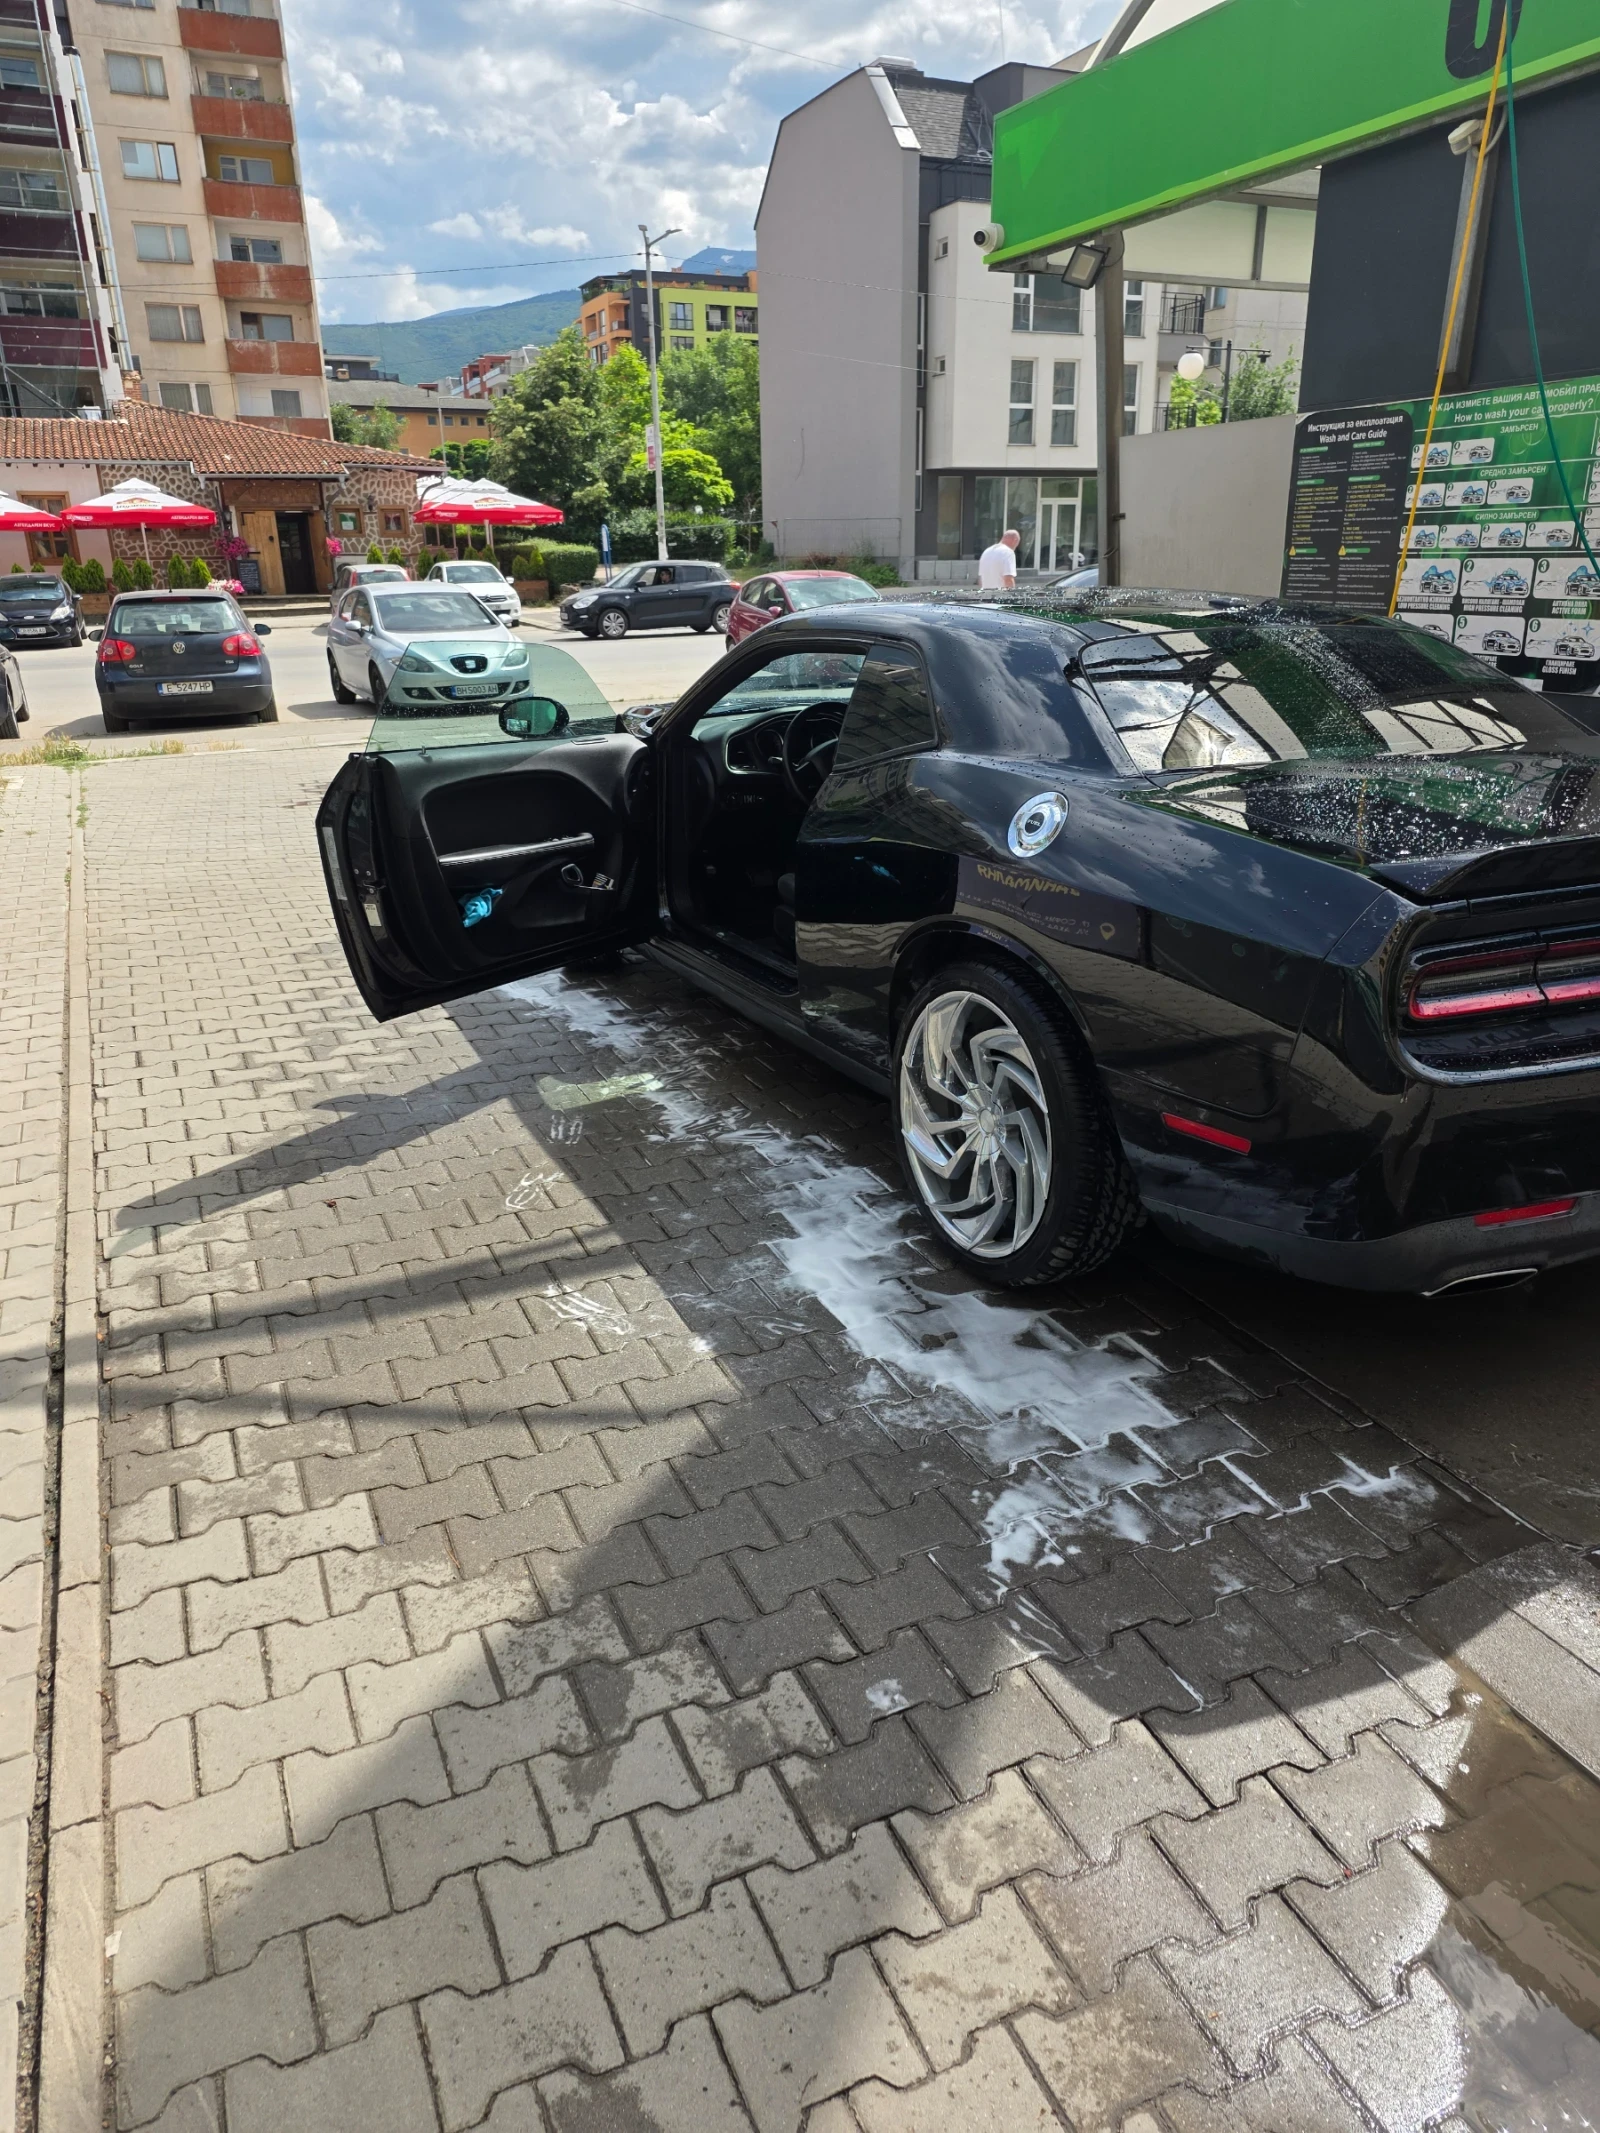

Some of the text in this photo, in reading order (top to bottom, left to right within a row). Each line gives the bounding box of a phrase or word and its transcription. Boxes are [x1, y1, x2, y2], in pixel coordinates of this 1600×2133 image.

[1443, 402, 1454, 412] ДА
[1456, 397, 1491, 410] ИЗМИЕТЕ
[1492, 393, 1522, 404] ВАШИЯ
[1454, 413, 1472, 423] How
[1474, 412, 1482, 421] to
[1484, 409, 1506, 419] wash
[1508, 407, 1529, 419] your
[1308, 422, 1345, 432] Инструкция
[1355, 416, 1403, 427] експлоатация
[1500, 423, 1538, 434] ЗАМЪРСЕН
[1320, 429, 1388, 443] Wash and Care Guide
[1480, 465, 1546, 477] СРЕДНО ЗАМЪРСЕН
[1499, 512, 1537, 520] ЗАМЪРСЕН
[1542, 666, 1577, 675] GLOSS FINISH
[177, 683, 197, 692] 5247
